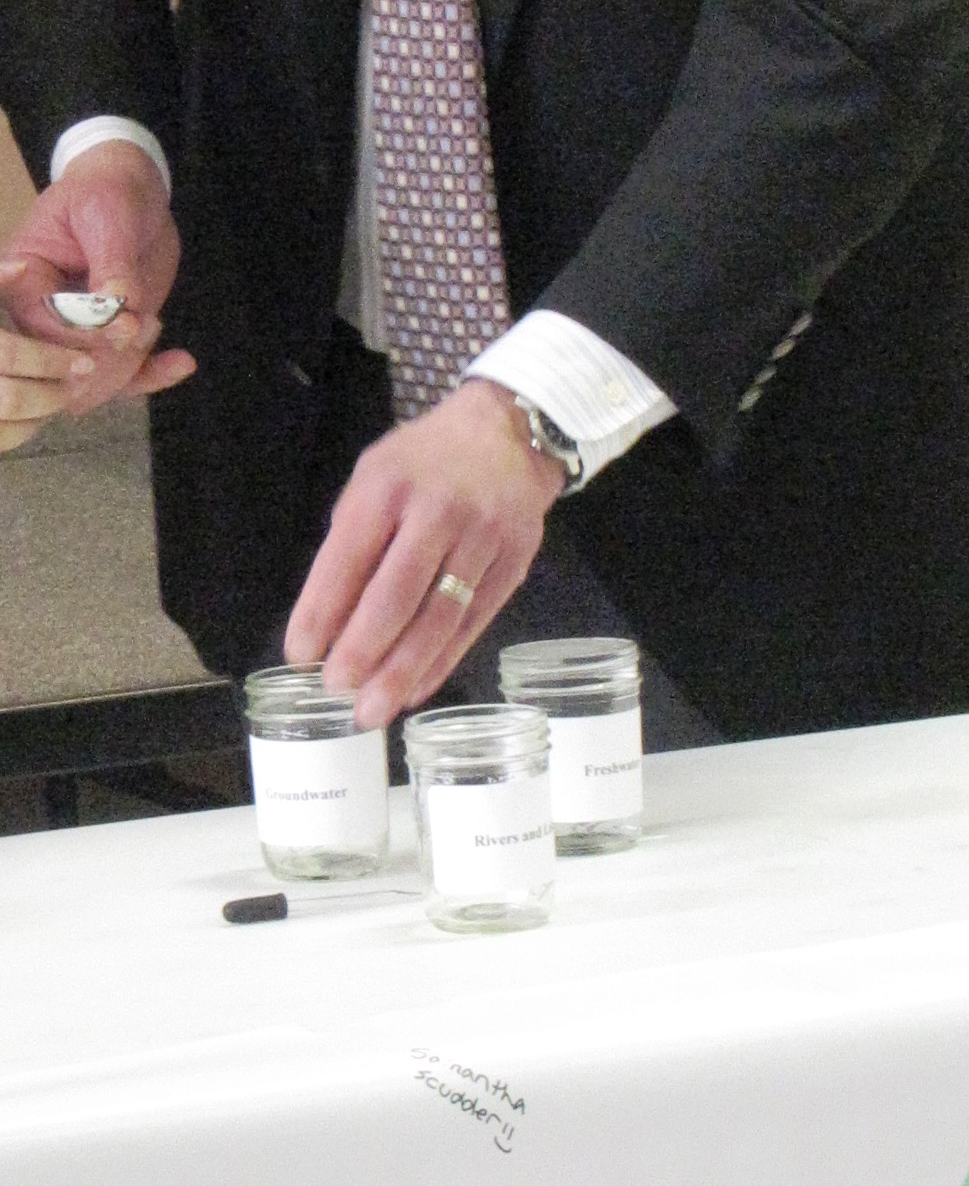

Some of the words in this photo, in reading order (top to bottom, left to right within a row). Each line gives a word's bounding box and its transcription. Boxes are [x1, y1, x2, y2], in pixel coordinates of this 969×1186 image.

[265, 787, 348, 801] Groundwater
[474, 833, 519, 847] Rivers
[521, 825, 543, 842] and
